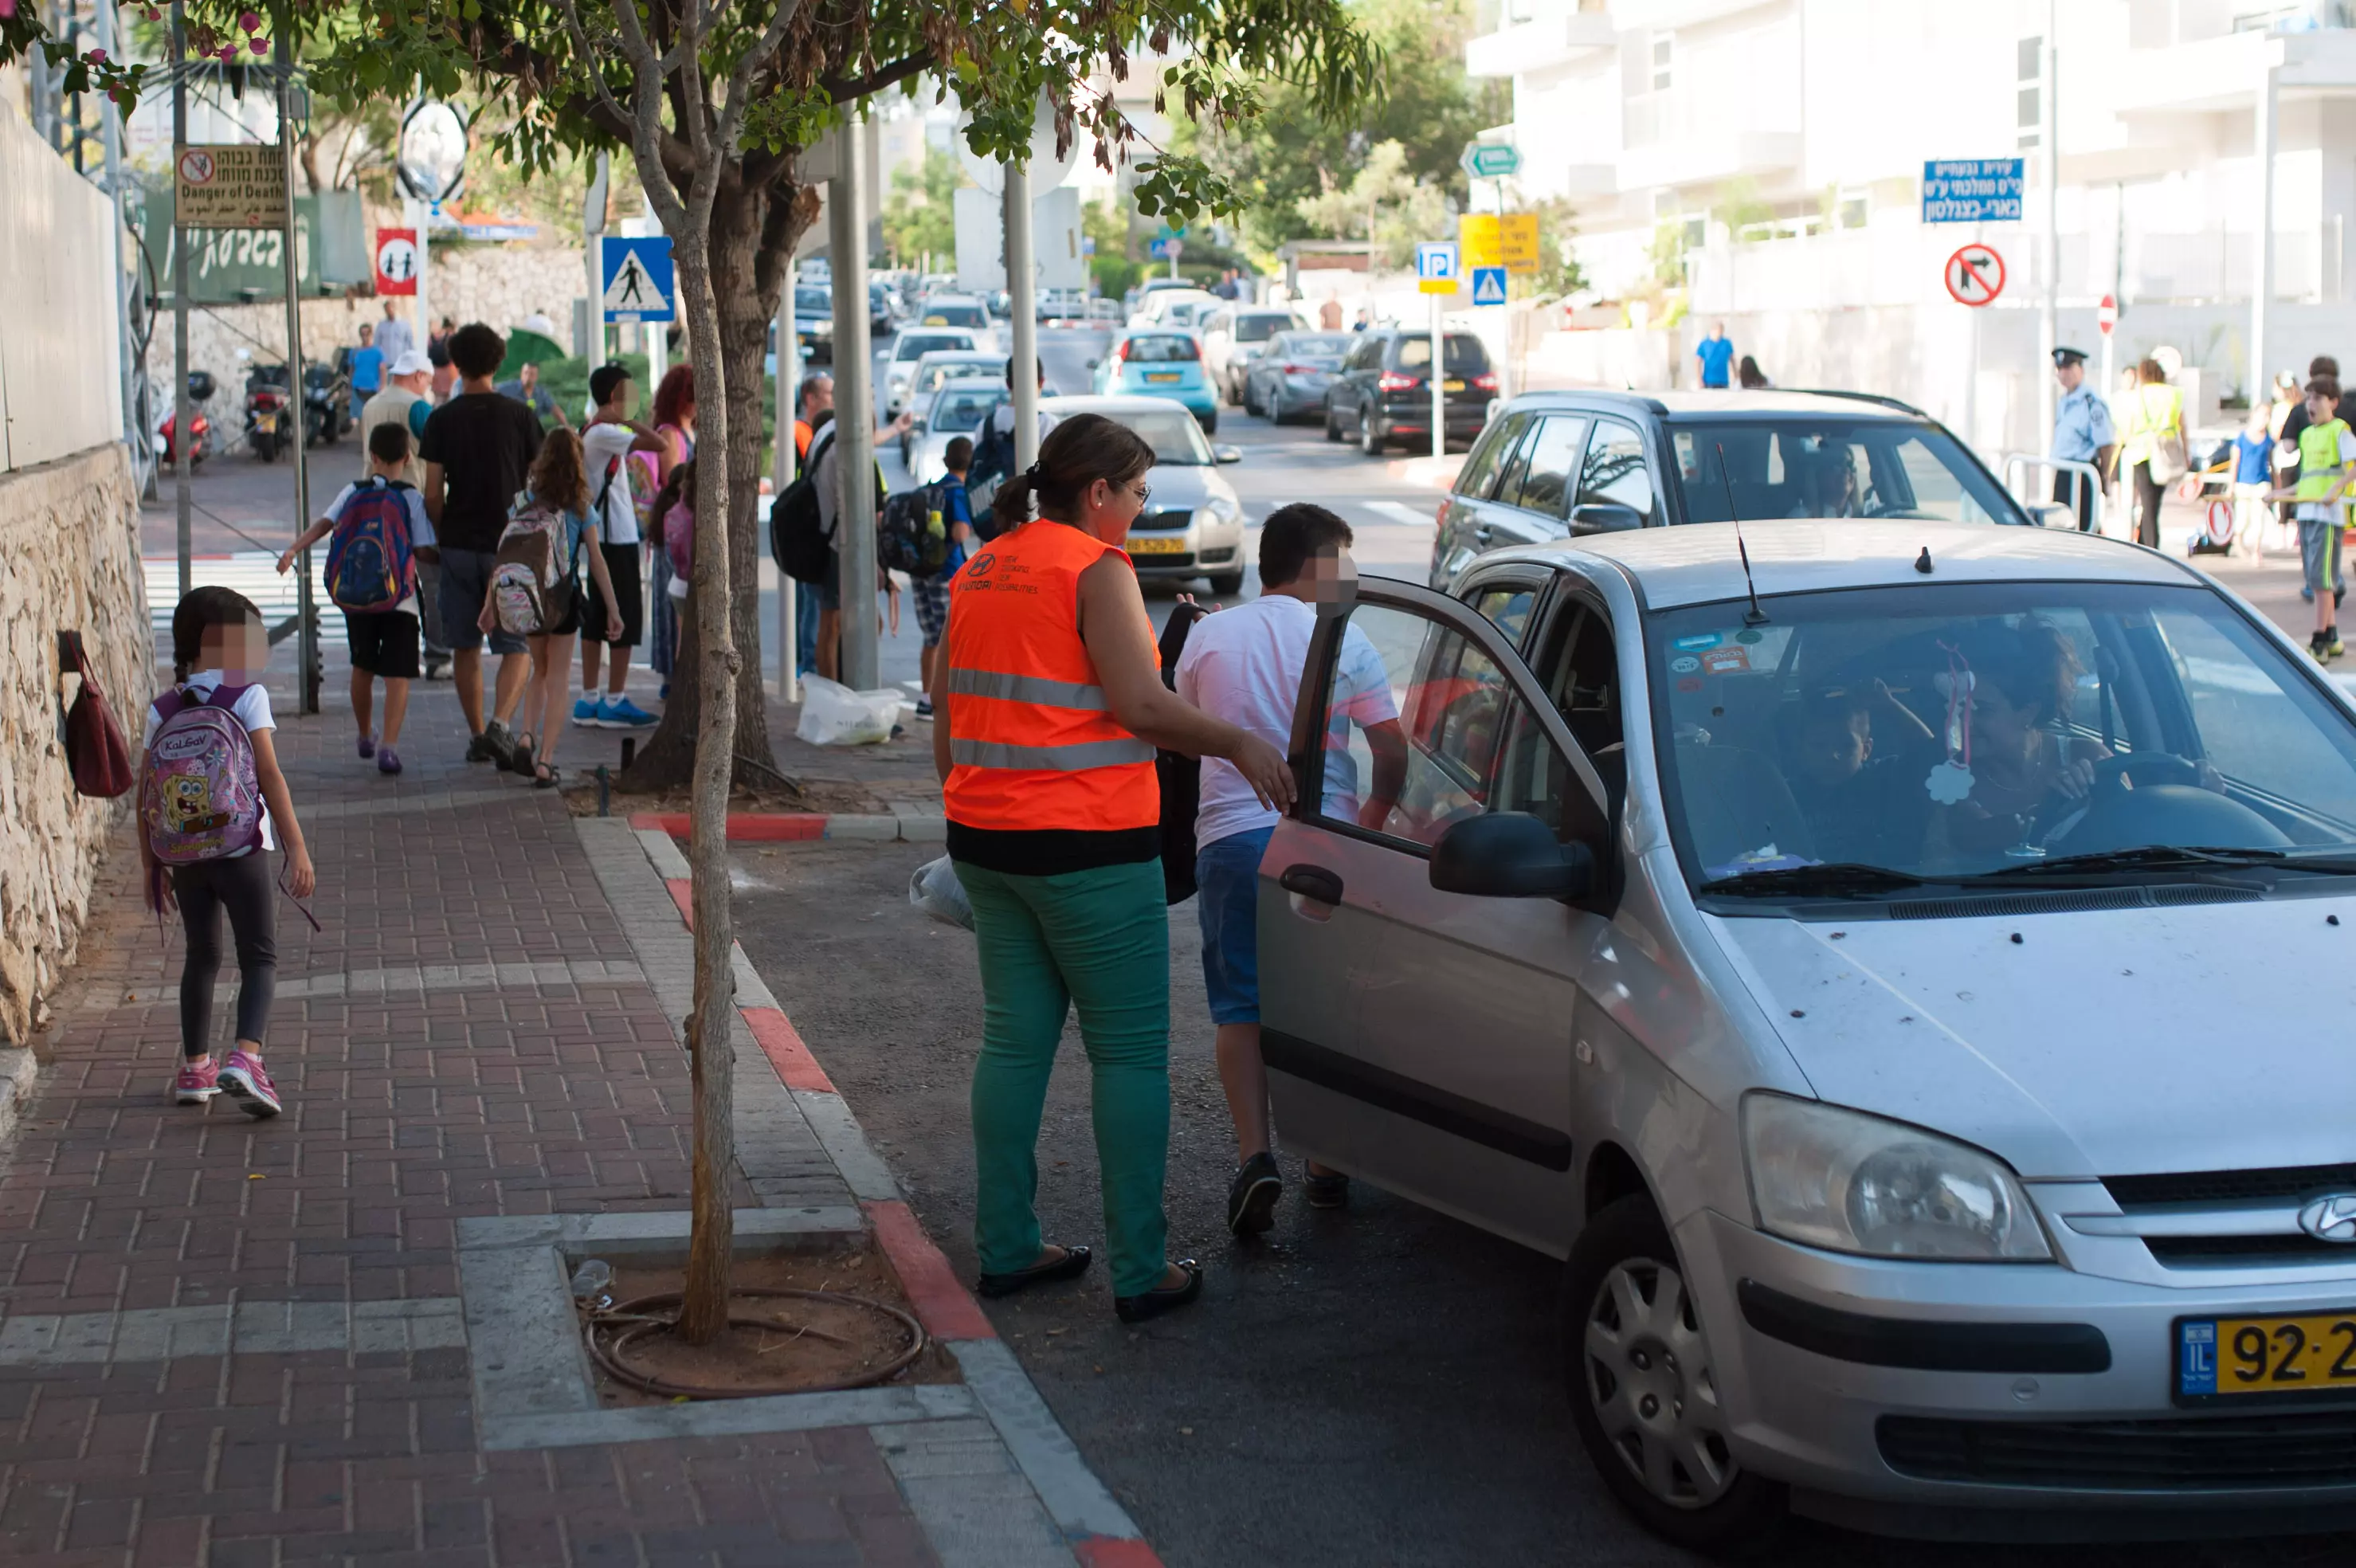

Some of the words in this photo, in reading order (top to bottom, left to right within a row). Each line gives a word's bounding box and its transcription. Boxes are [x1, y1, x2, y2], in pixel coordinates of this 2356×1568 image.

[182, 185, 225, 202] Danger
[229, 184, 242, 198] of
[2190, 1343, 2211, 1372] IL
